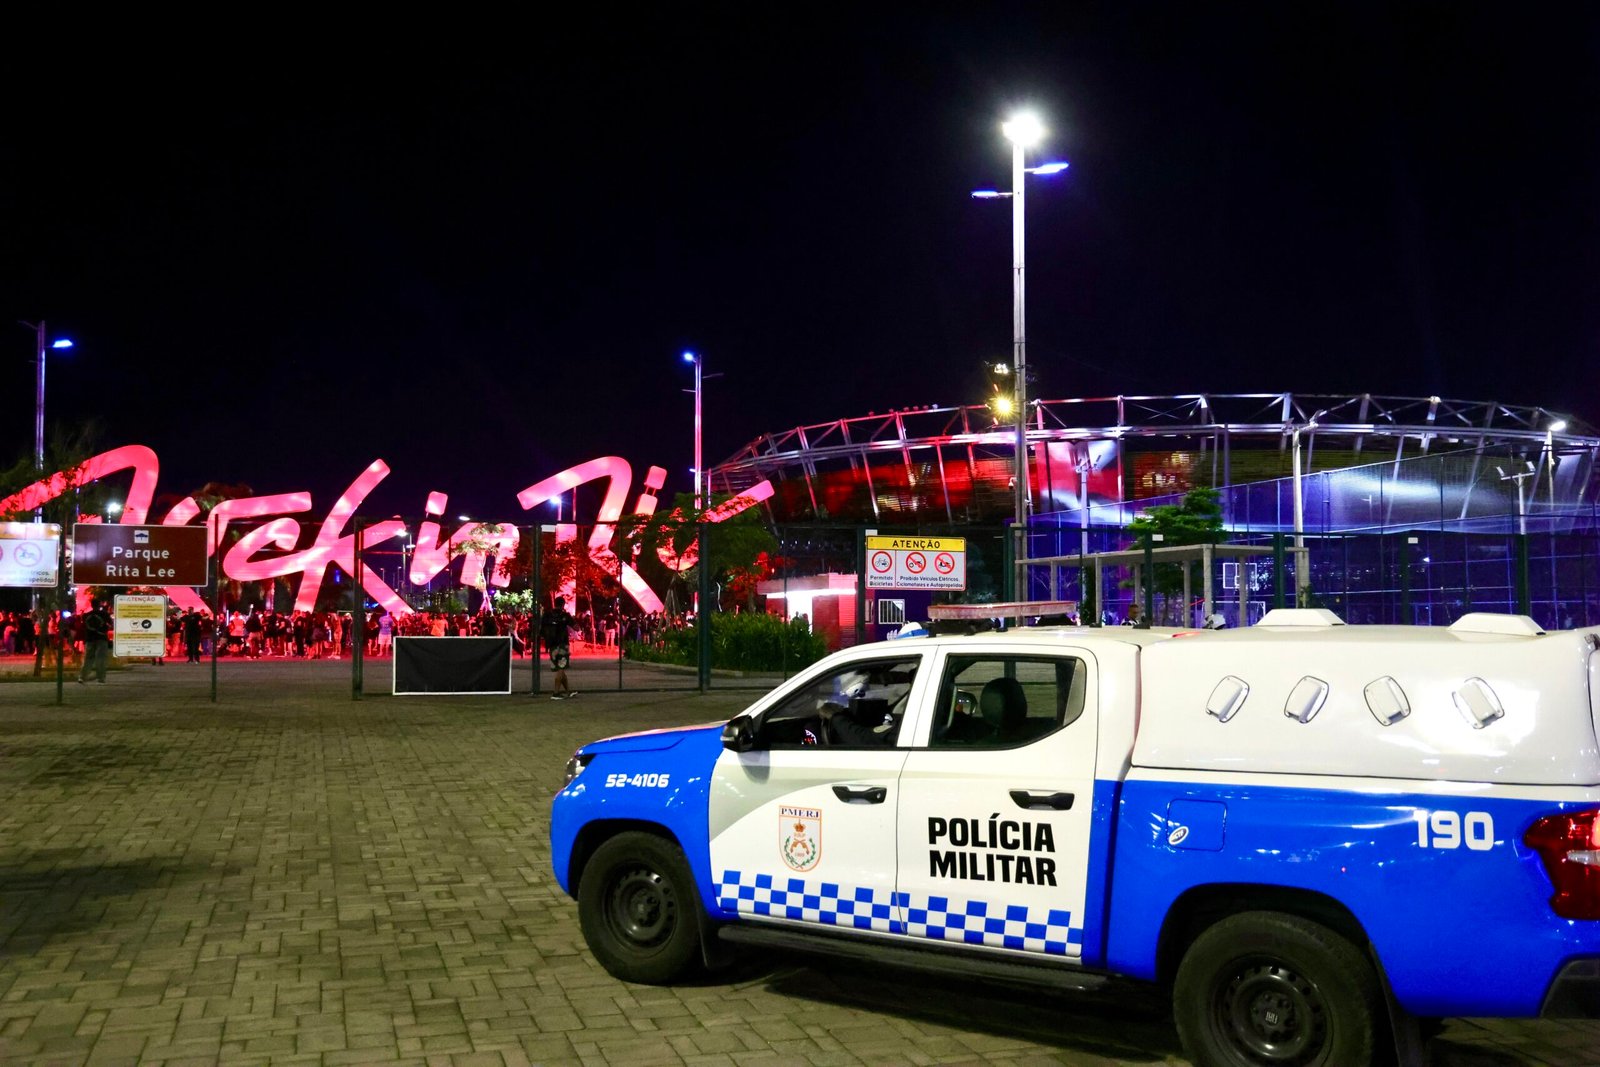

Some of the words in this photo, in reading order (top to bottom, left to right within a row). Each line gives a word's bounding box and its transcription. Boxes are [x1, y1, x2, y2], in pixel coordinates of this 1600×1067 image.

[410, 491, 520, 587] in
[892, 539, 941, 550] ATENÇÃO
[112, 546, 170, 561] Parque
[106, 565, 139, 577] Rita
[146, 565, 176, 577] Lee
[605, 773, 670, 788] 52-4106
[781, 807, 819, 818] PMERJ
[928, 812, 1056, 853] POLÍCIA
[1413, 810, 1495, 851] 190
[929, 850, 1058, 887] MILITAR
